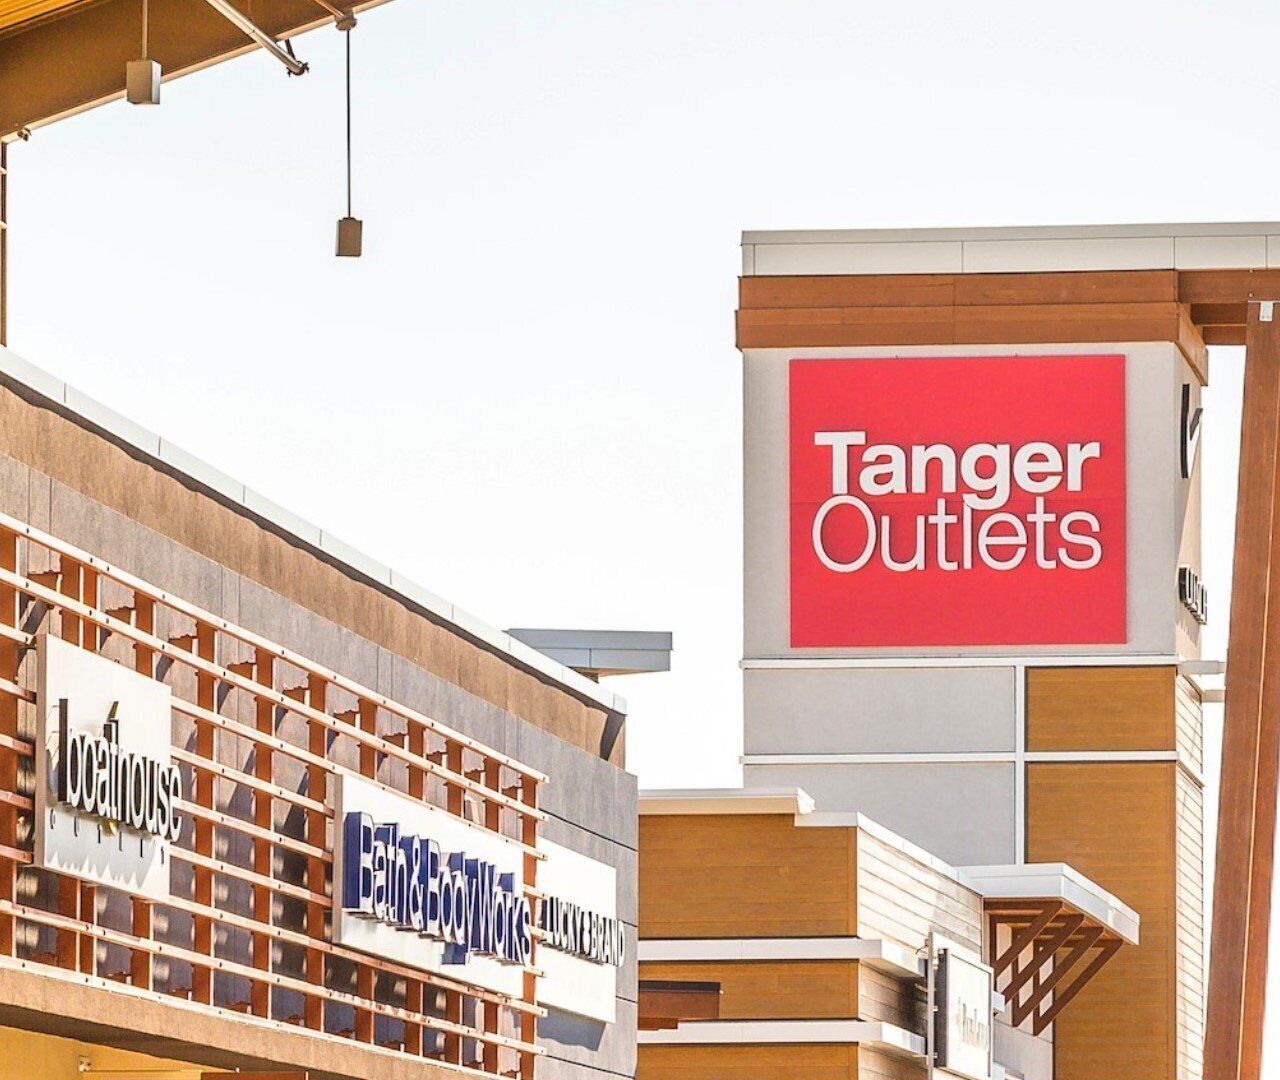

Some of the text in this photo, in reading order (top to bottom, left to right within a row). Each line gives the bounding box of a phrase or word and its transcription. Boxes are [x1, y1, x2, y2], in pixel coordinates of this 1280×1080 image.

[814, 430, 1101, 510] Tanger
[811, 495, 1103, 572] Outlets
[58, 699, 182, 843] boathouse
[343, 811, 407, 925] Bath
[421, 839, 476, 966] Body
[476, 858, 531, 967] Works
